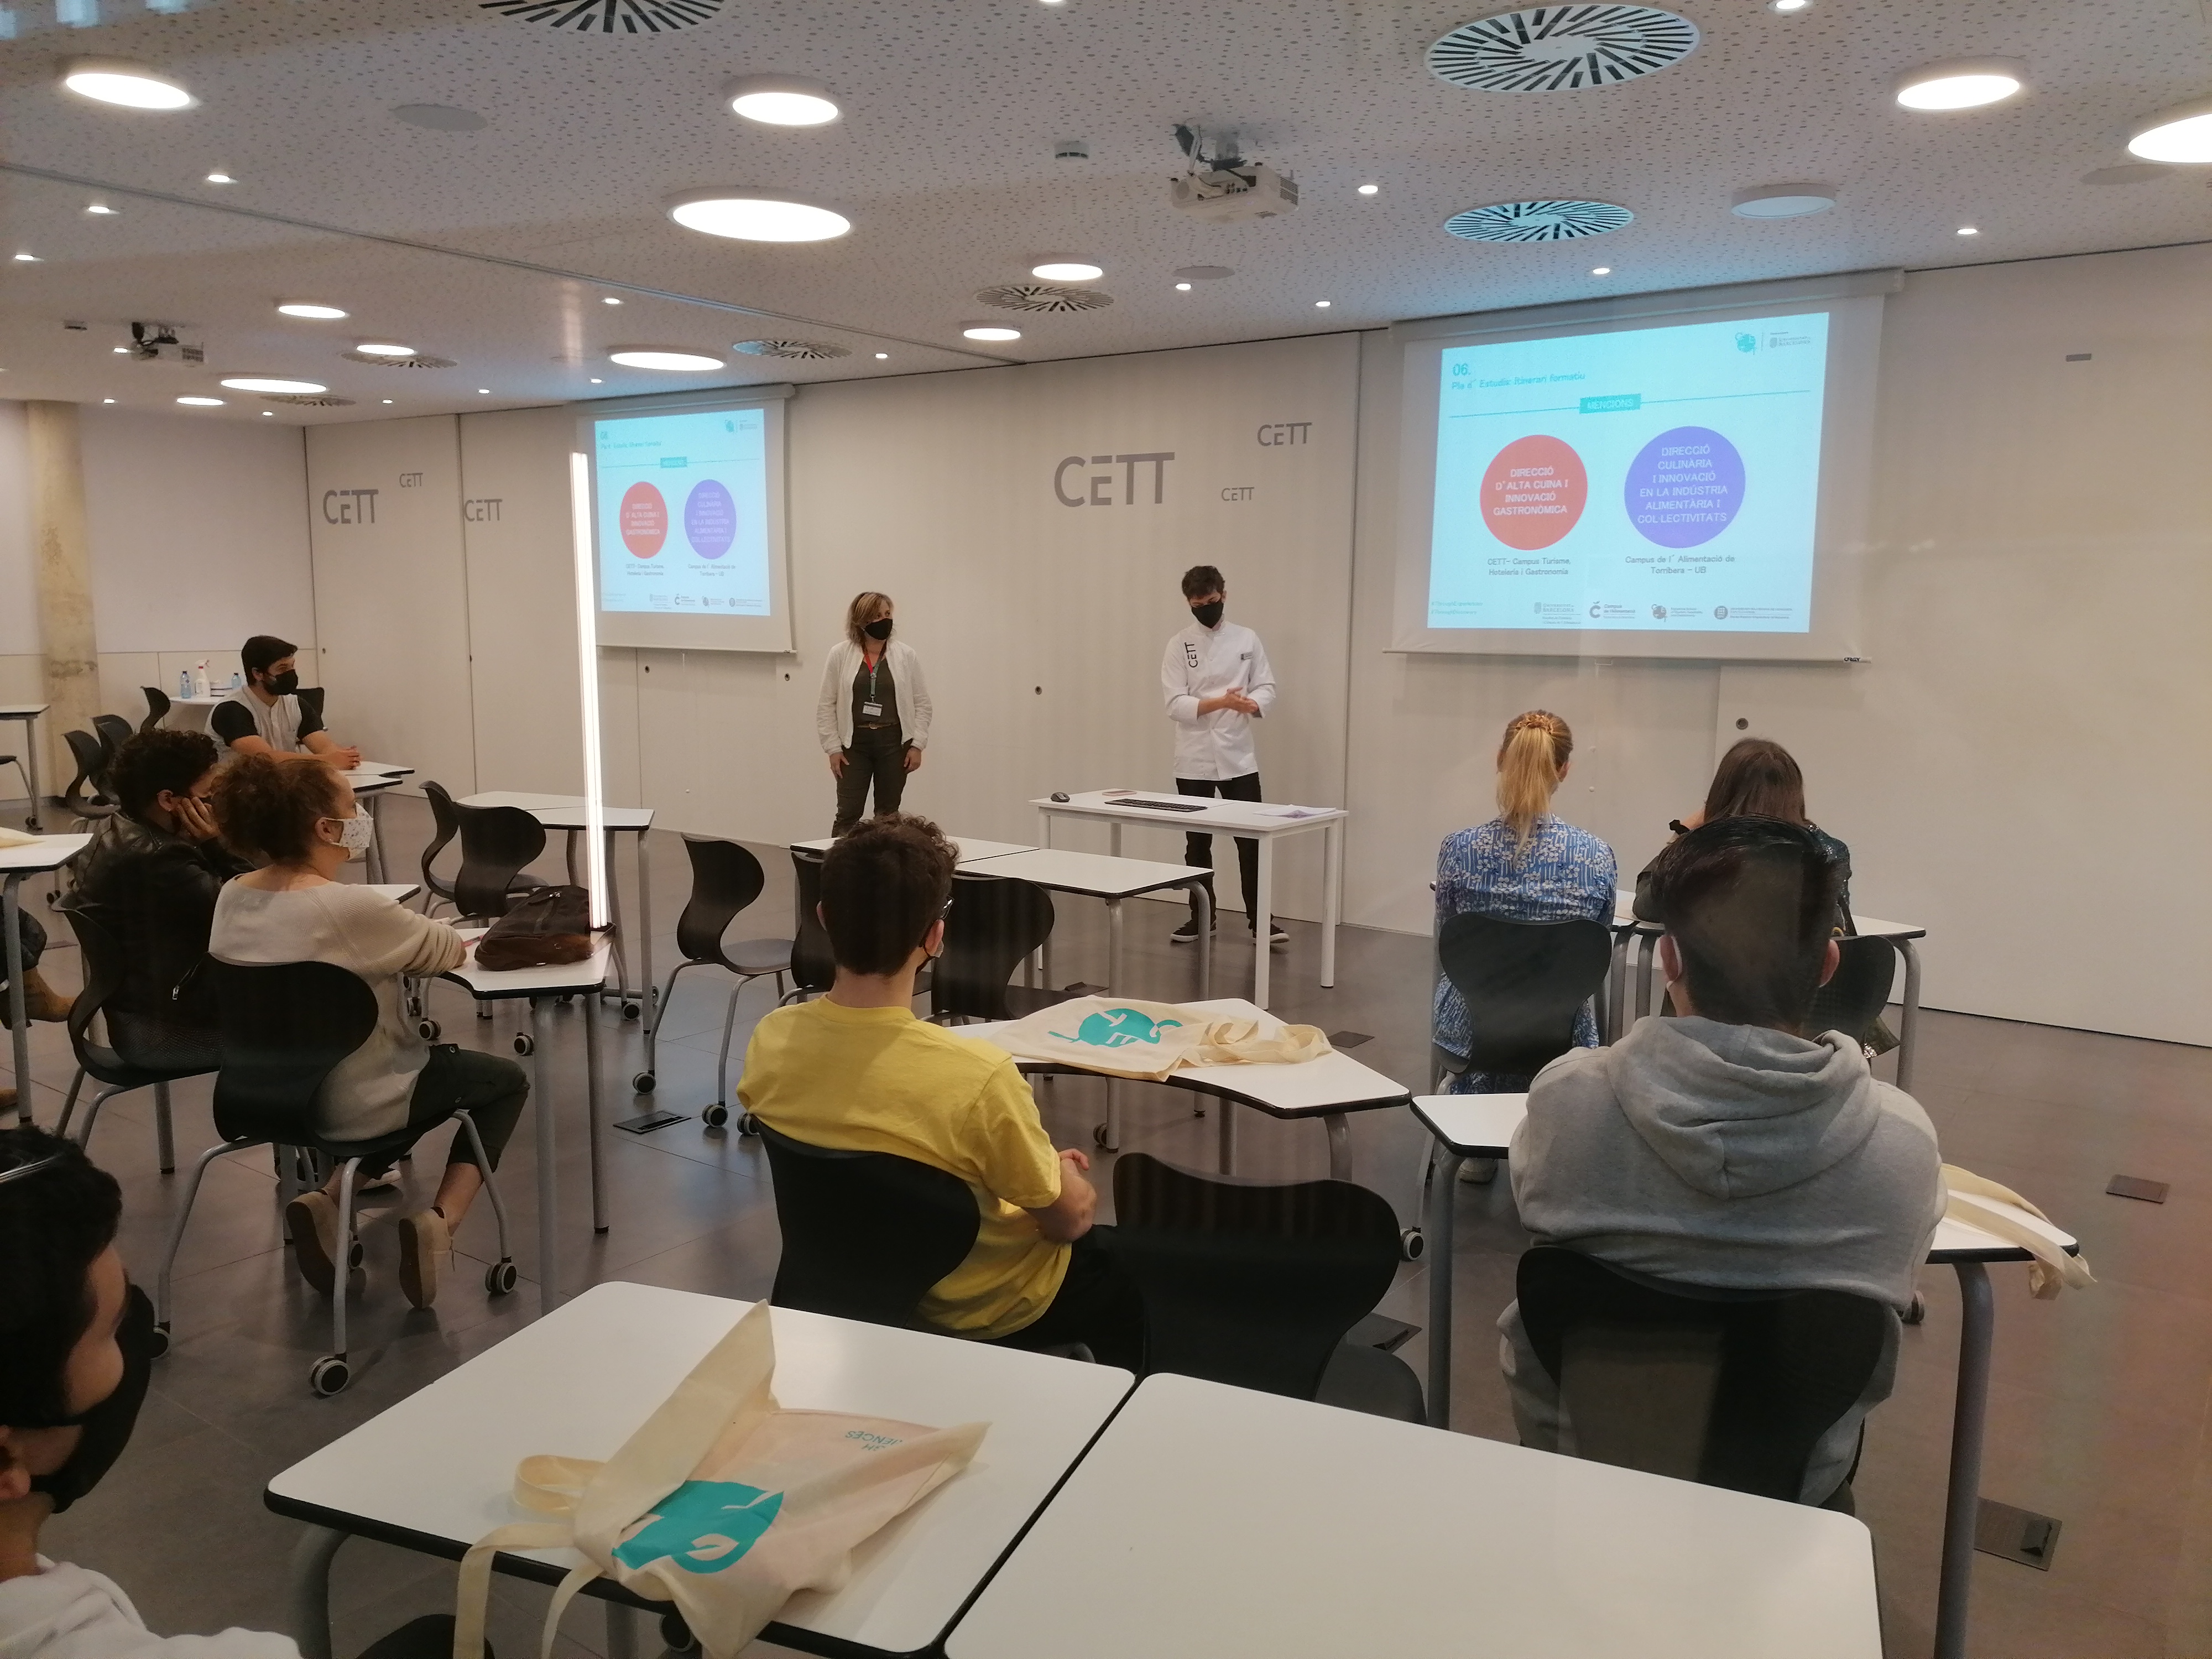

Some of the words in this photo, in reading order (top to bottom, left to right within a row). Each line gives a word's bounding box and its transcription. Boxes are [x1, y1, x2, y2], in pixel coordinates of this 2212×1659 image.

[1257, 422, 1312, 447] CETT
[1661, 444, 1710, 456] DIRECCIÓ
[1658, 458, 1712, 470] CULINÀRIA
[1510, 465, 1554, 478] DIRECCIÓ
[1659, 470, 1716, 483] INNOVACIÓ
[399, 472, 424, 488] CETT
[1054, 452, 1175, 508] CETT
[1533, 479, 1562, 489] CUINA
[1221, 487, 1254, 502] CETT
[1505, 491, 1557, 503] INNOVACIÓ
[1640, 488, 1653, 497] EN
[1657, 488, 1669, 497] LA
[1672, 484, 1728, 496] INDÚSTRIA
[323, 489, 379, 525] CETT
[463, 498, 503, 522] CETT
[1645, 498, 1713, 510] ALIMENTÀRIA
[1625, 556, 1655, 564] Campus
[1678, 555, 1722, 563] Alimentació
[1184, 642, 1198, 668] CETT
[845, 1431, 902, 1446] IENCES
